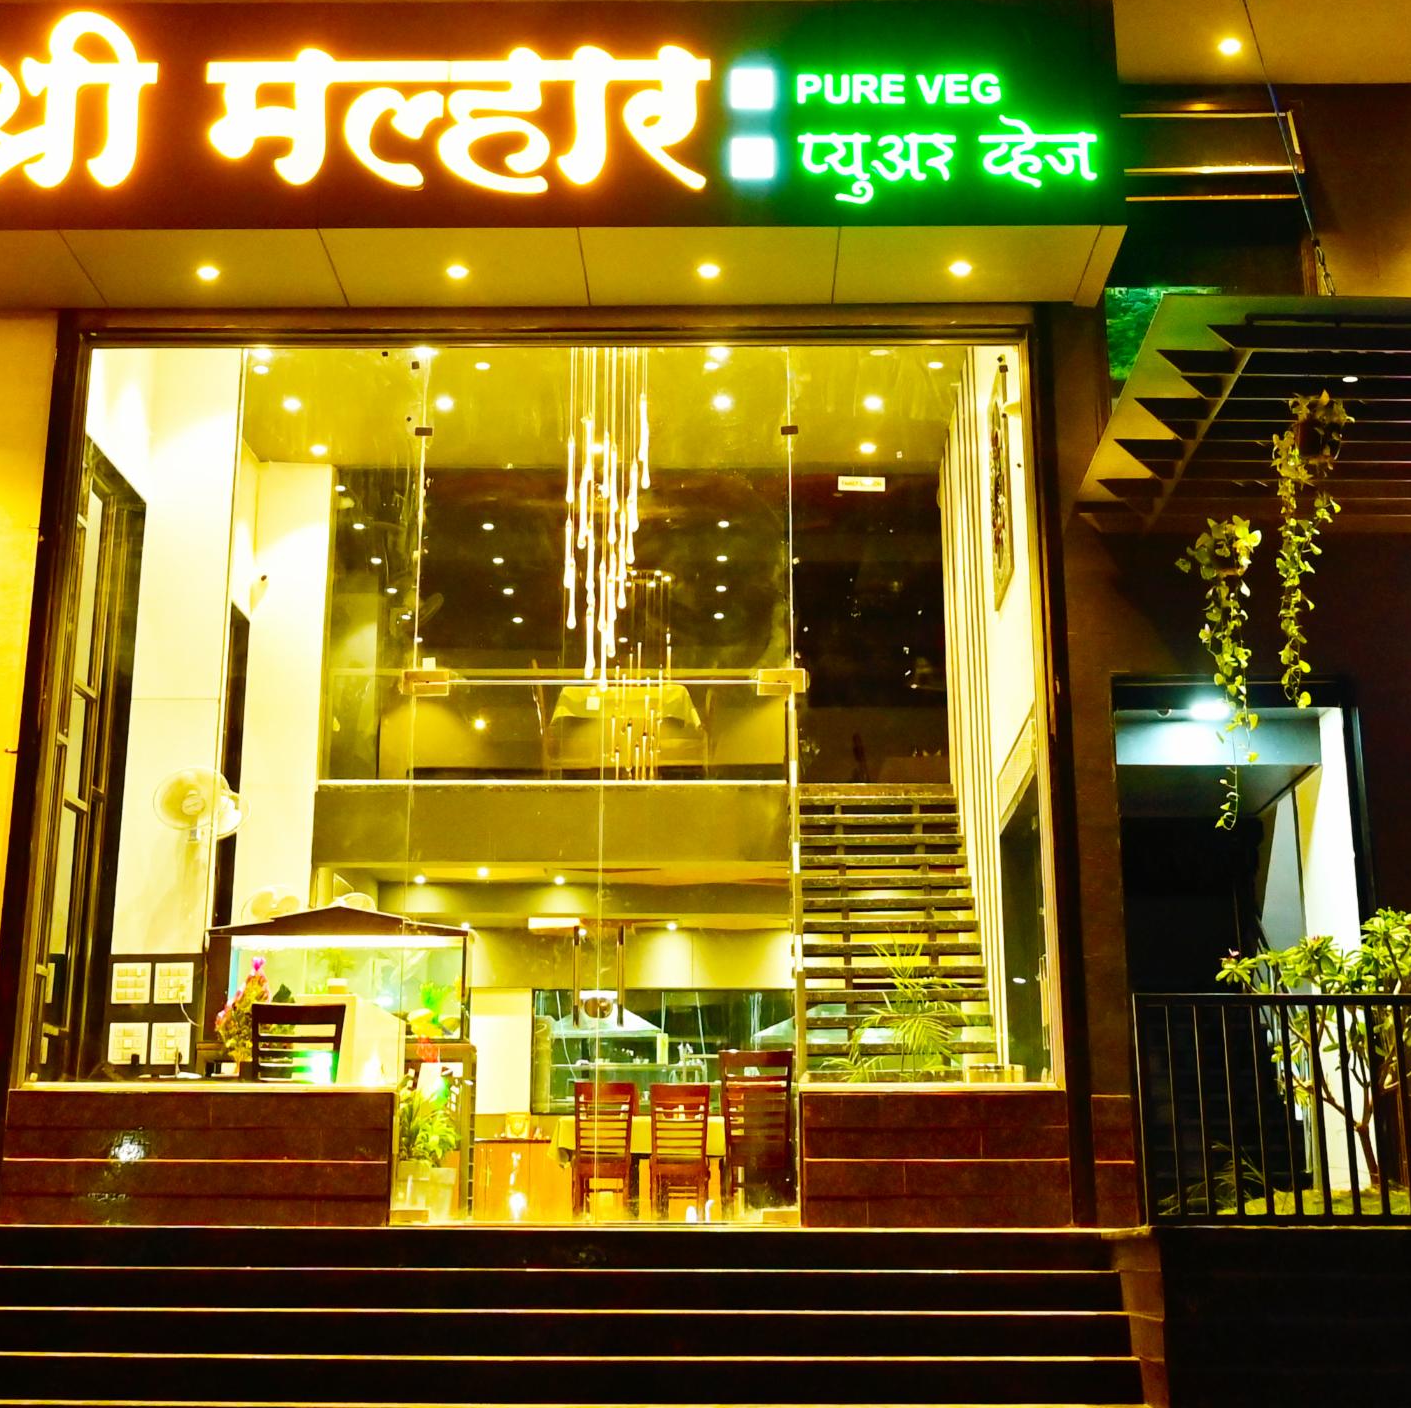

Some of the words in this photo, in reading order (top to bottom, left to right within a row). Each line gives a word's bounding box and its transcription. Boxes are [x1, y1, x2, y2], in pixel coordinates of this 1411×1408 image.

[206, 44, 712, 193] मल्हार
[796, 73, 905, 104] PURE
[915, 72, 1001, 104] VEG
[797, 132, 956, 204] प्युअर
[978, 114, 1097, 187] व्हेज
